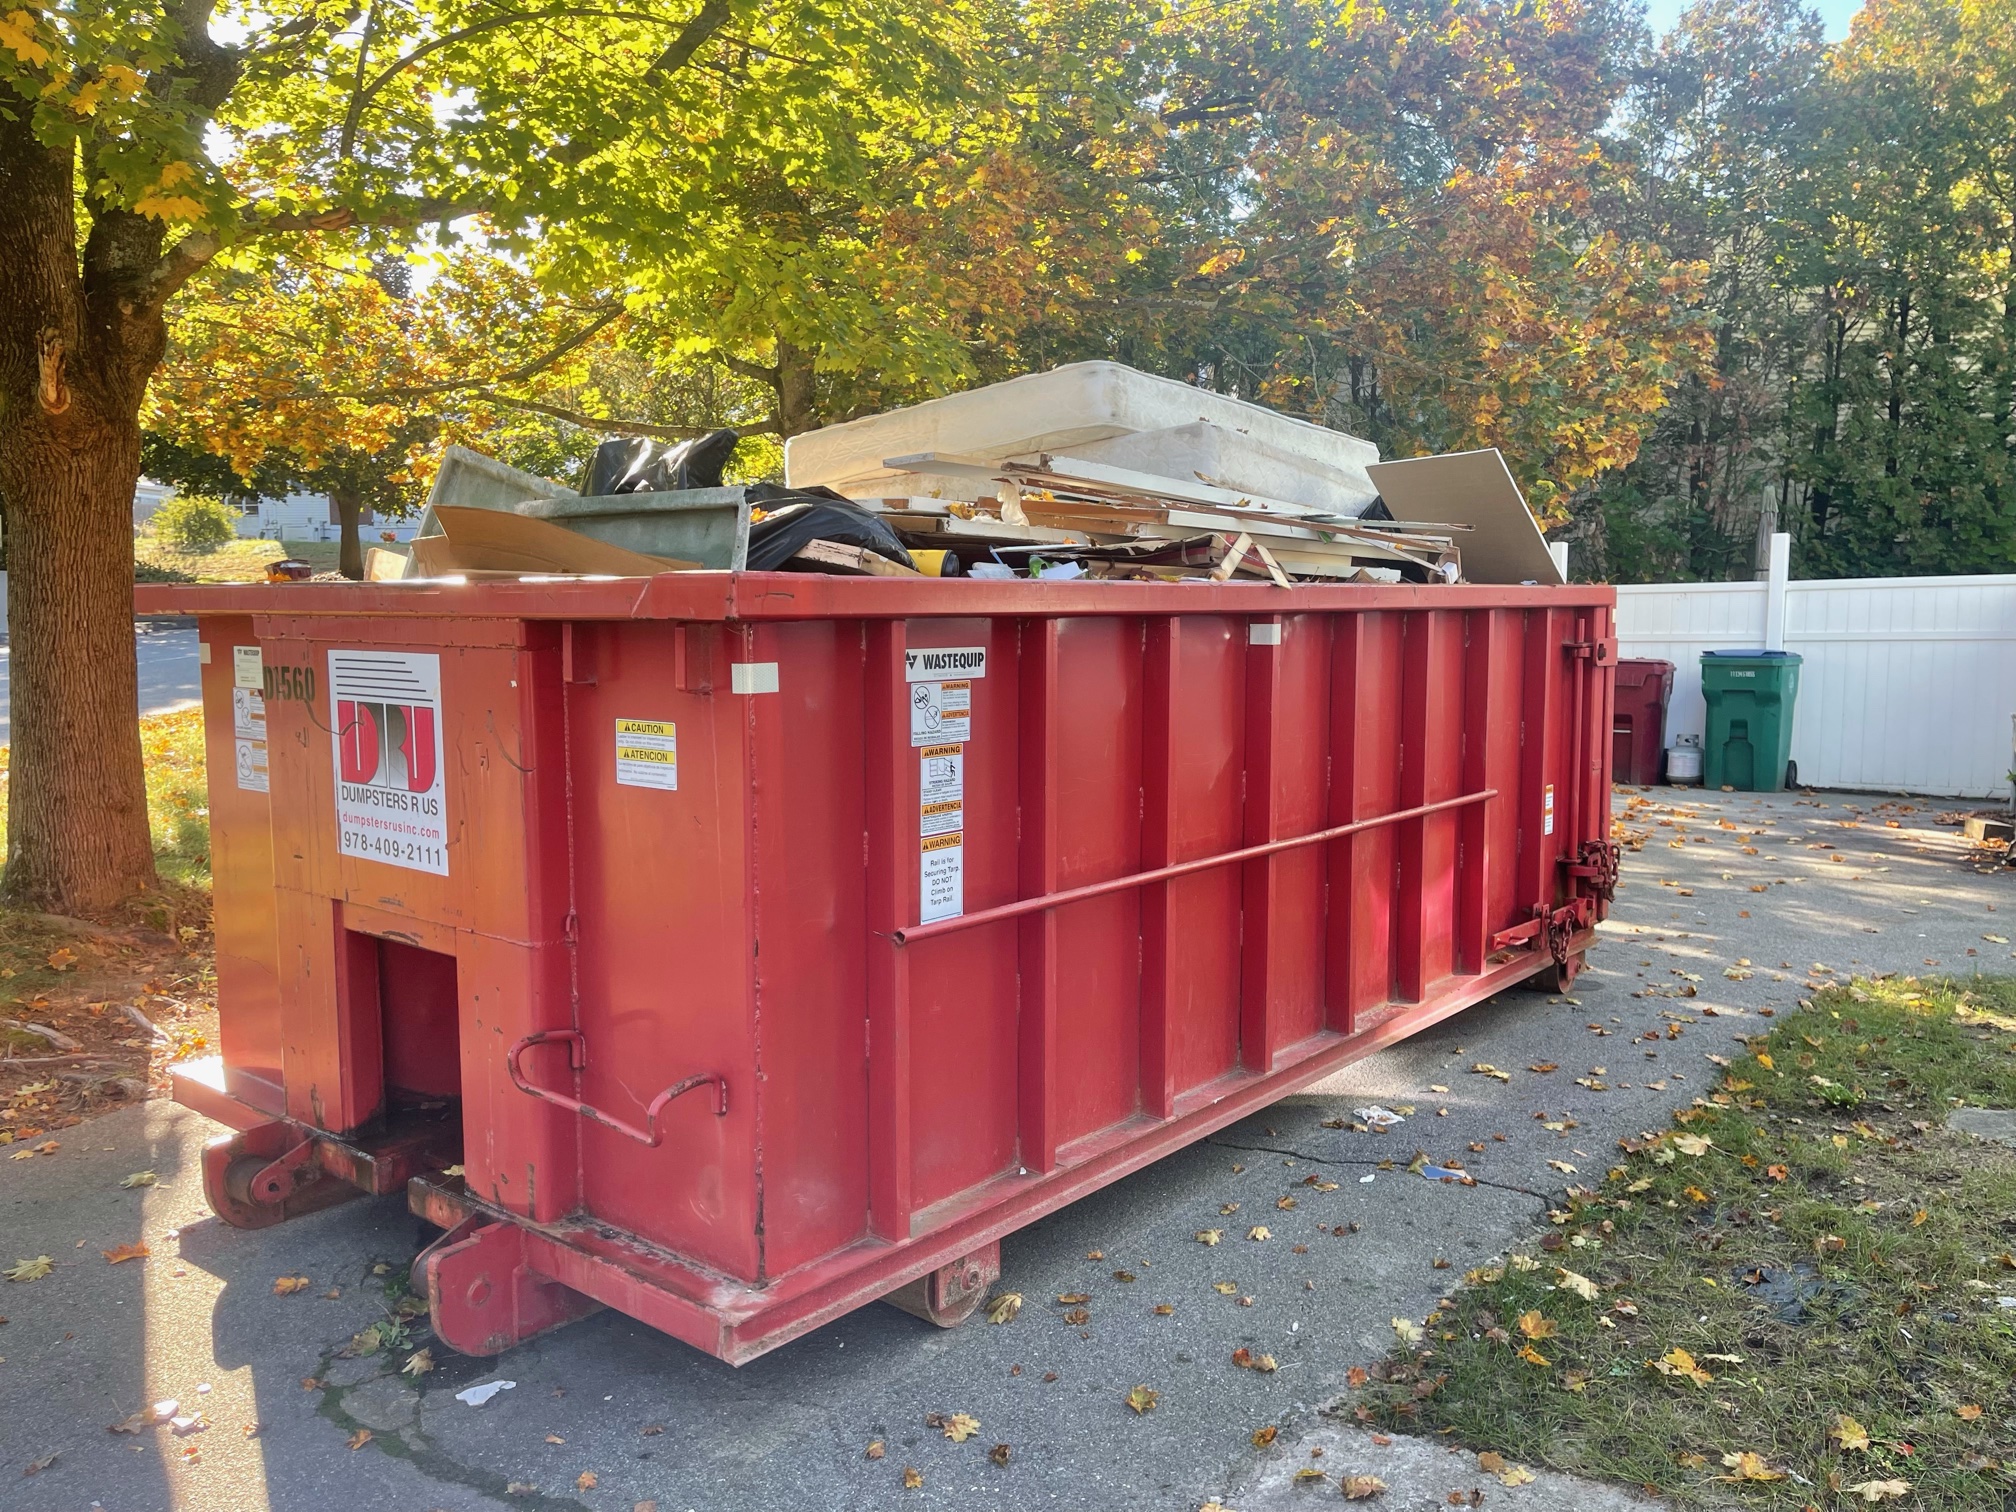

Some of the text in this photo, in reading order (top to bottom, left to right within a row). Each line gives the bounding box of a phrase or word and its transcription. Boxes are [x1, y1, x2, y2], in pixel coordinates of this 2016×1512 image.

[923, 652, 984, 670] WASTEQUIP
[263, 666, 315, 702] D1560
[631, 723, 664, 734] CAUTION
[630, 750, 668, 762] ATENCION
[928, 746, 960, 756] WARNING
[341, 785, 438, 816] DUMPSTERS R US
[929, 802, 962, 813] ADVERTENCIA
[342, 811, 440, 840] dumpstersrusinc.com
[344, 830, 441, 867] 978-409-2111
[928, 836, 960, 849] WARNING
[924, 868, 946, 878] Securing
[942, 876, 952, 884] NOT
[931, 888, 946, 896] Climb
